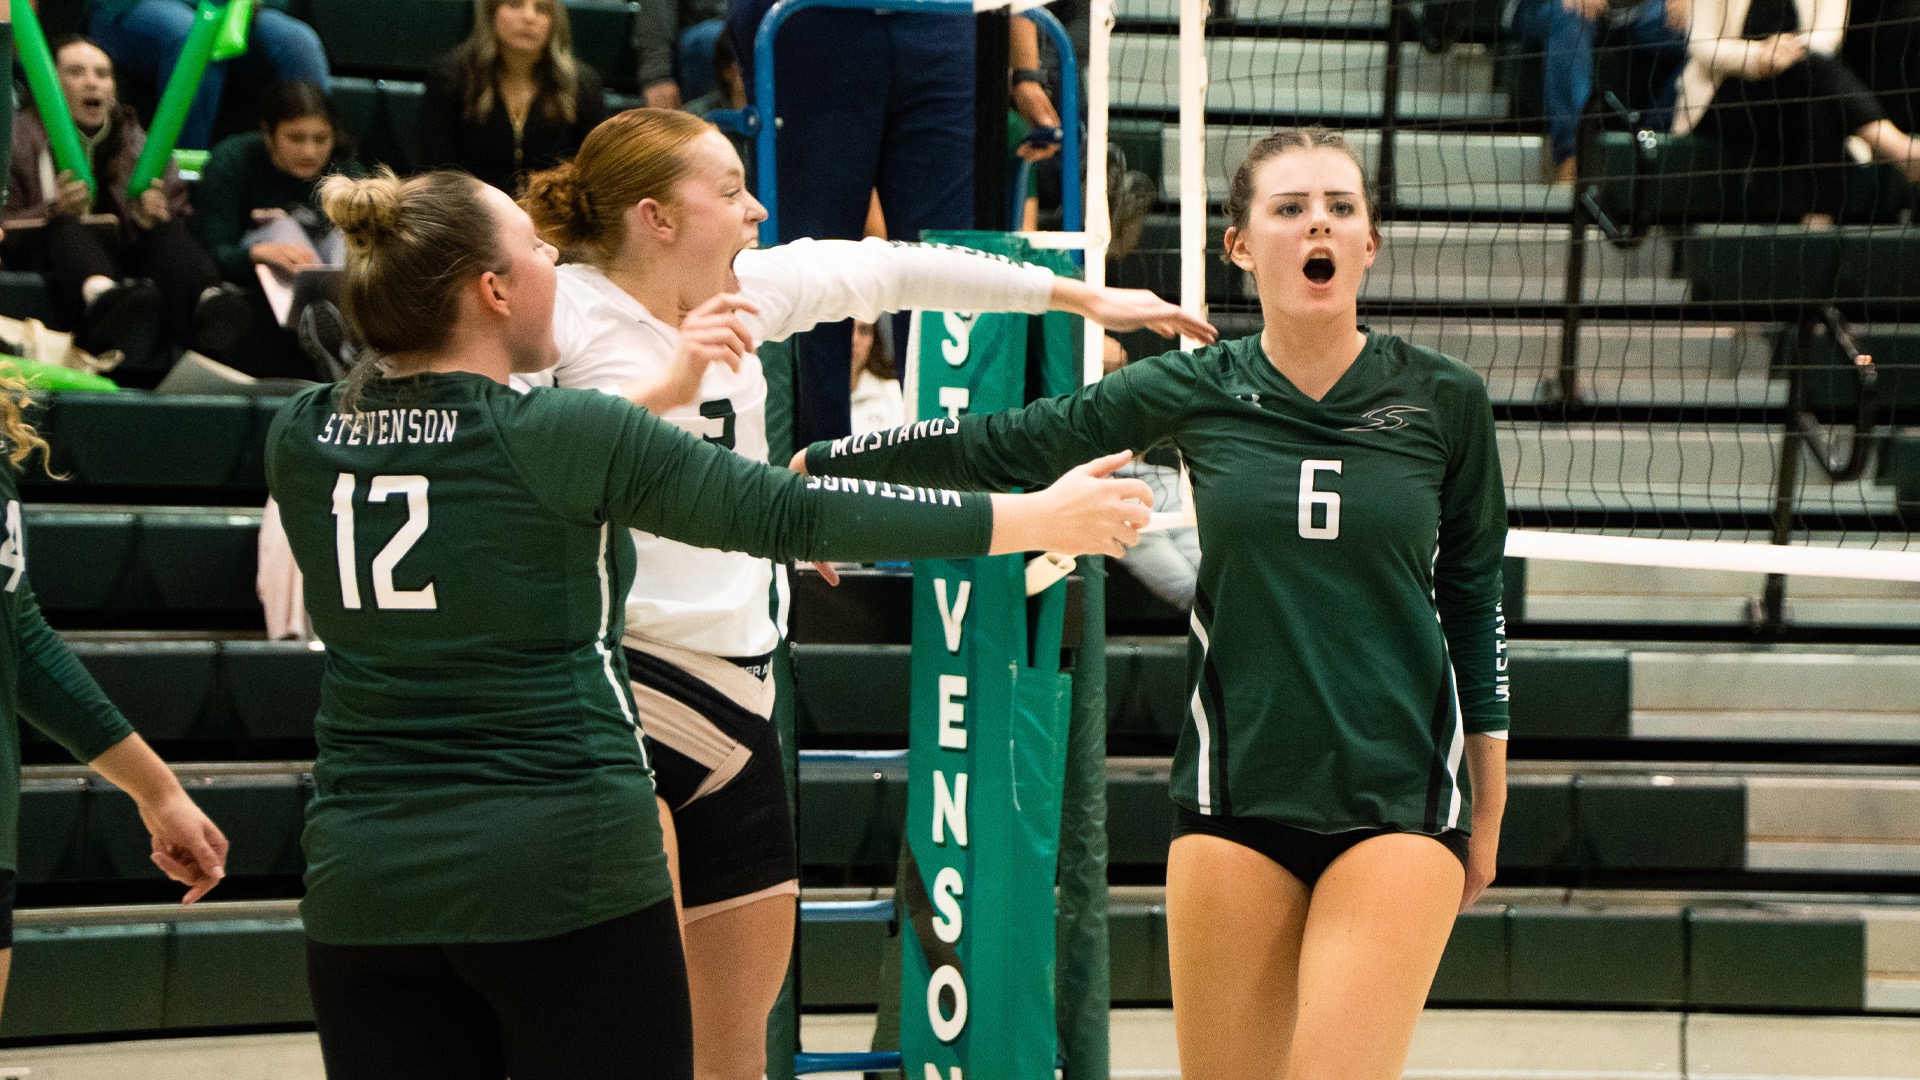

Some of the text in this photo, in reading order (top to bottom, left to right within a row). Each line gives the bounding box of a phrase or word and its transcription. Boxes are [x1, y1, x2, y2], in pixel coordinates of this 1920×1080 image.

[317, 408, 458, 445] STEVENSON
[331, 472, 438, 609] 12
[1298, 459, 1343, 541] 6
